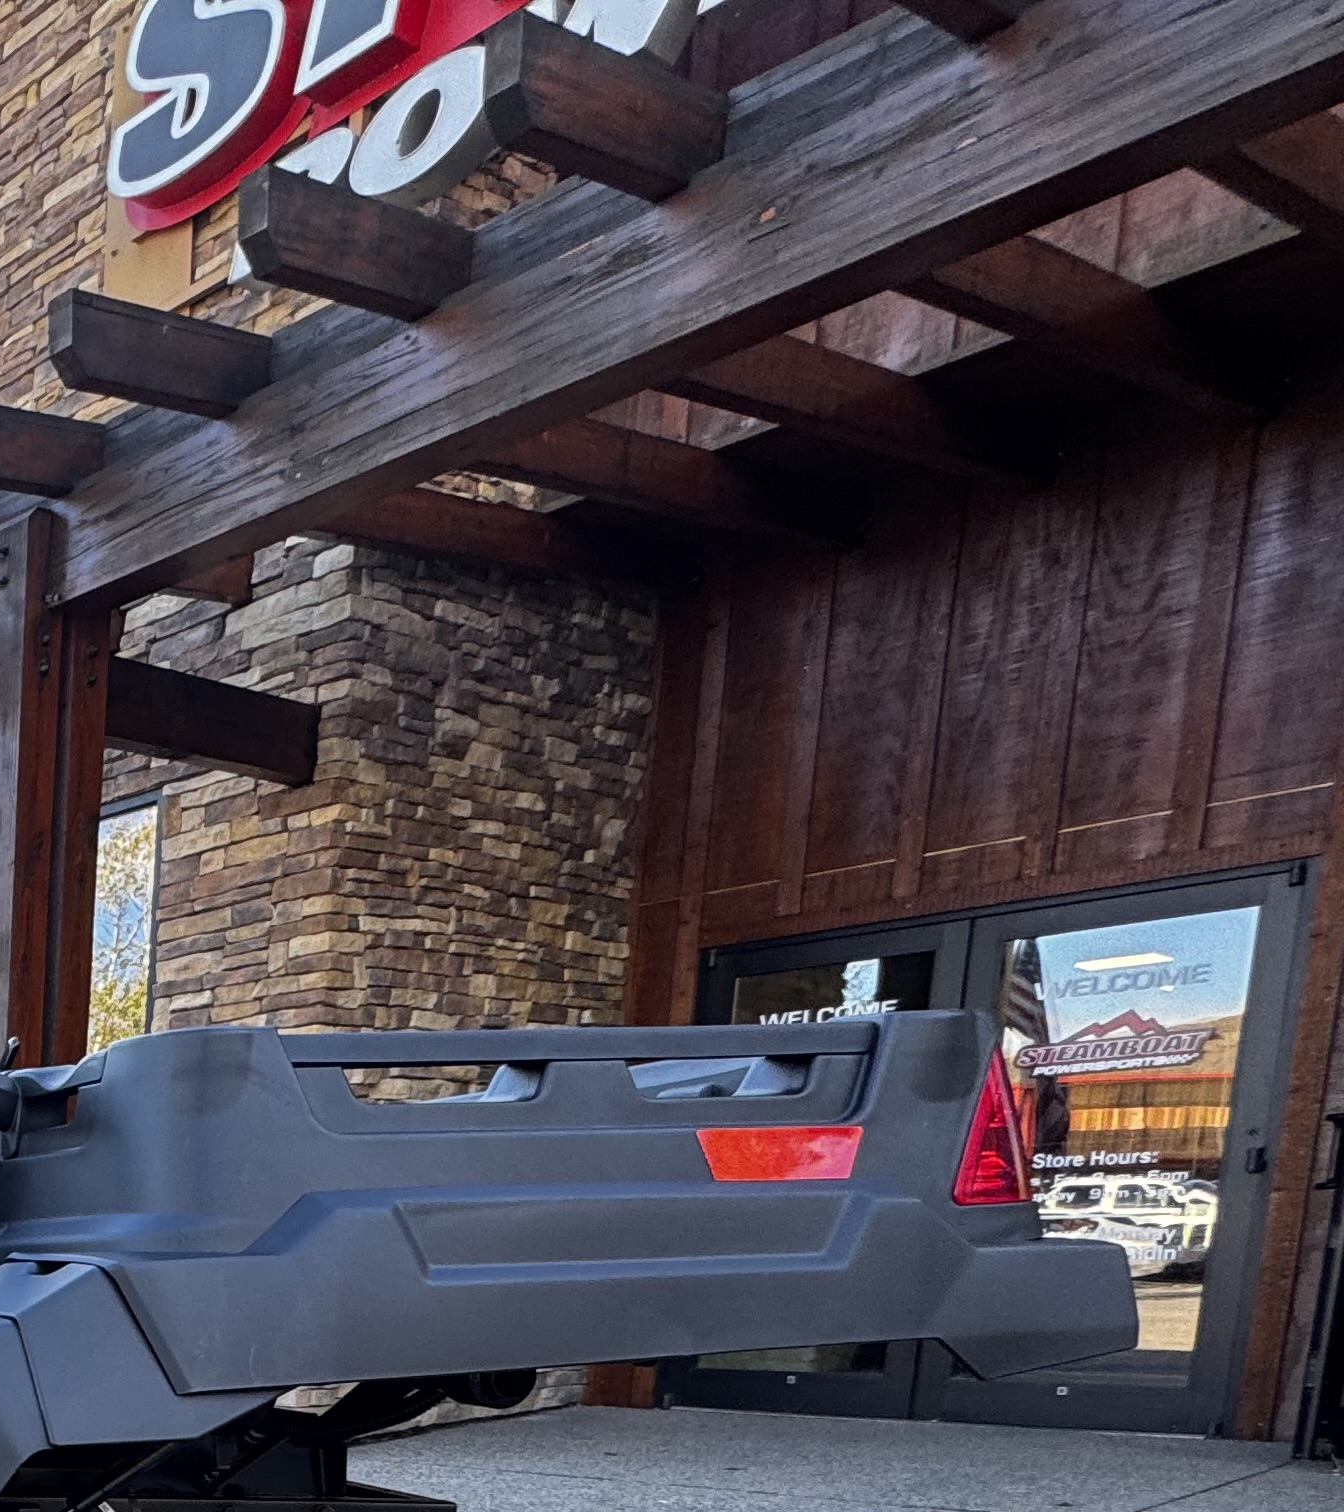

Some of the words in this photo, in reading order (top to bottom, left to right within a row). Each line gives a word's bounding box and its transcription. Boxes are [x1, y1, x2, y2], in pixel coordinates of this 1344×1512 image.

[1034, 963, 1212, 1000] WELCOME
[1016, 1031, 1208, 1068] STEAMBOAT
[1032, 1056, 1170, 1077] POWERSPORTS
[1031, 1154, 1086, 1169] Store
[1090, 1151, 1159, 1167] Hours:
